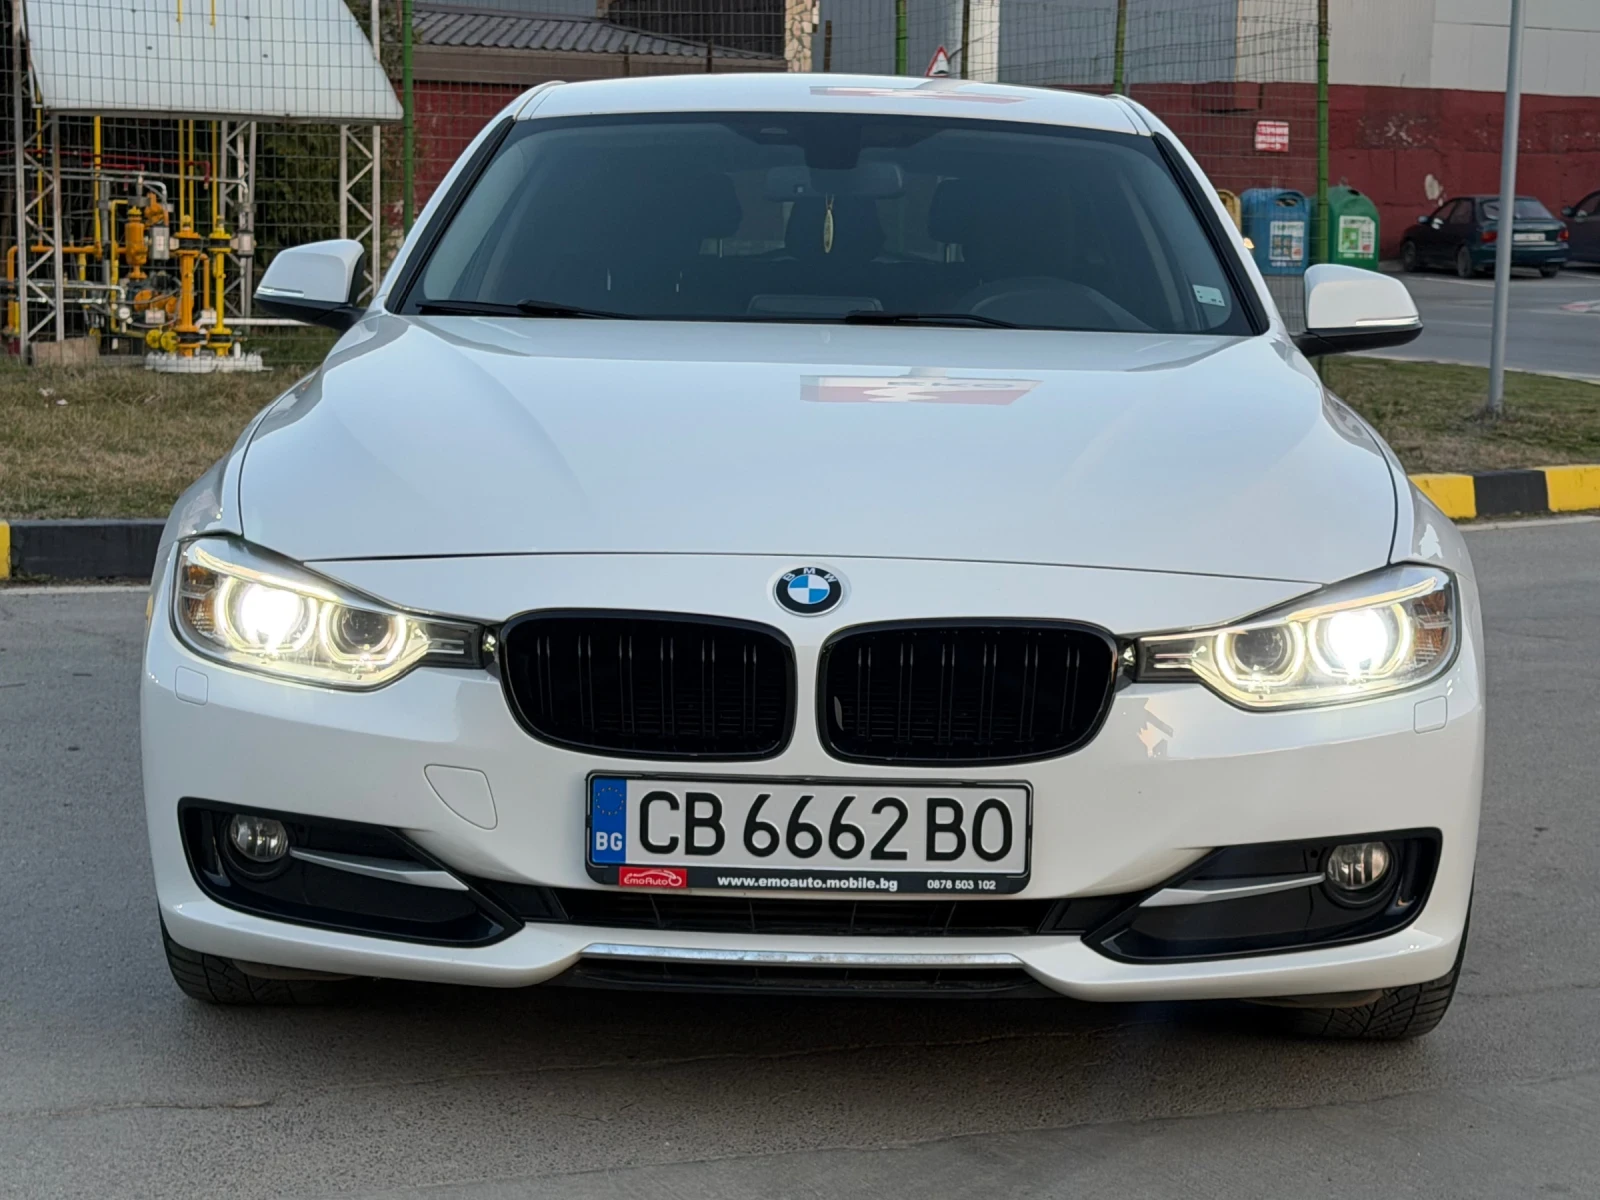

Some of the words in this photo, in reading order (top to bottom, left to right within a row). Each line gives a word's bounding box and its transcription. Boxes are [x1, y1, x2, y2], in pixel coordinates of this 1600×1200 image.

[782, 567, 838, 582] BMW
[639, 791, 725, 856] CB
[743, 793, 909, 860] 6662
[596, 832, 622, 851] BG
[624, 877, 669, 886] EmoAuto
[717, 877, 898, 892] www.emoauto.mobile.bg
[927, 879, 953, 889] 0878
[955, 879, 974, 890] 503
[978, 880, 996, 890] 102
